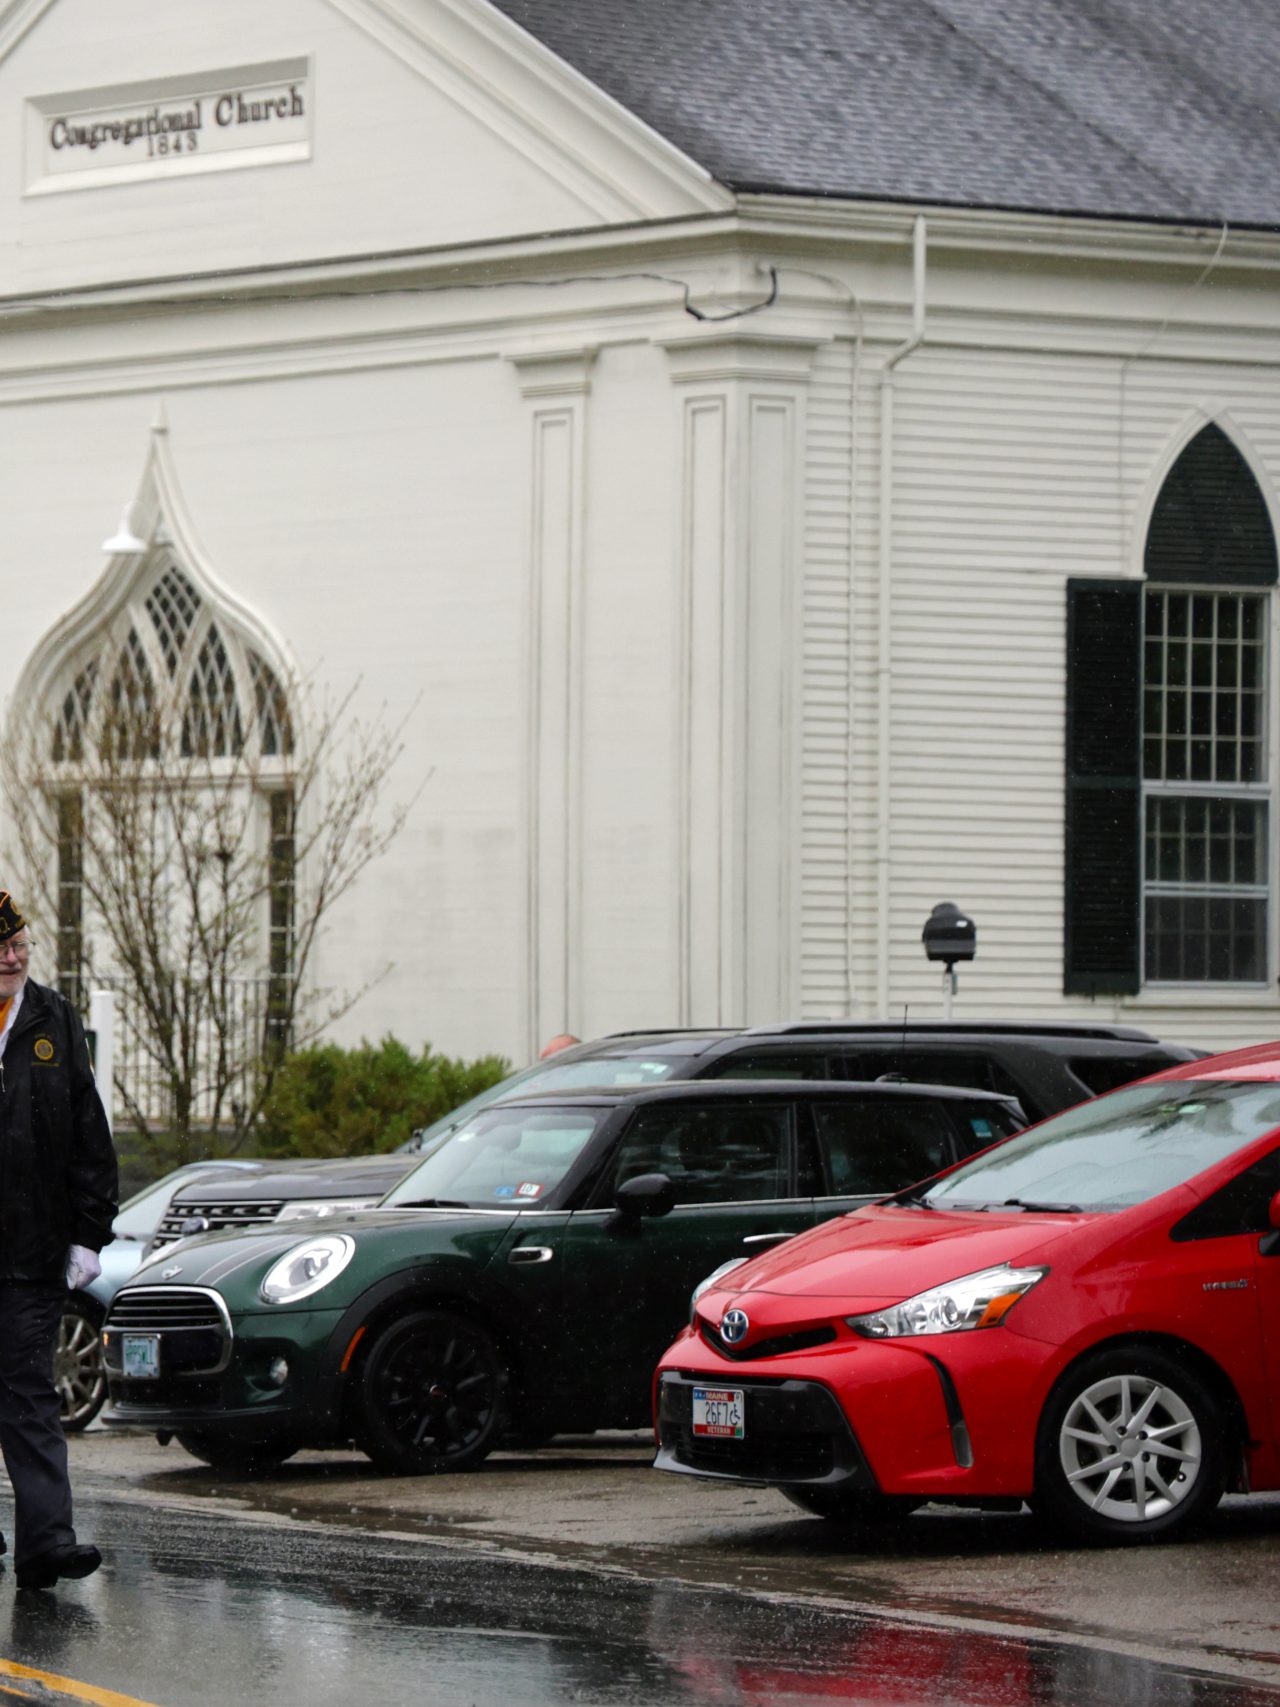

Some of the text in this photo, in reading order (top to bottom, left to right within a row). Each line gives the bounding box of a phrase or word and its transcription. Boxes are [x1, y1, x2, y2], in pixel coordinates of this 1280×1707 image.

[50, 85, 304, 150] Congregational Church
[705, 1391, 728, 1401] MAINE
[705, 1401, 728, 1426] 26F7
